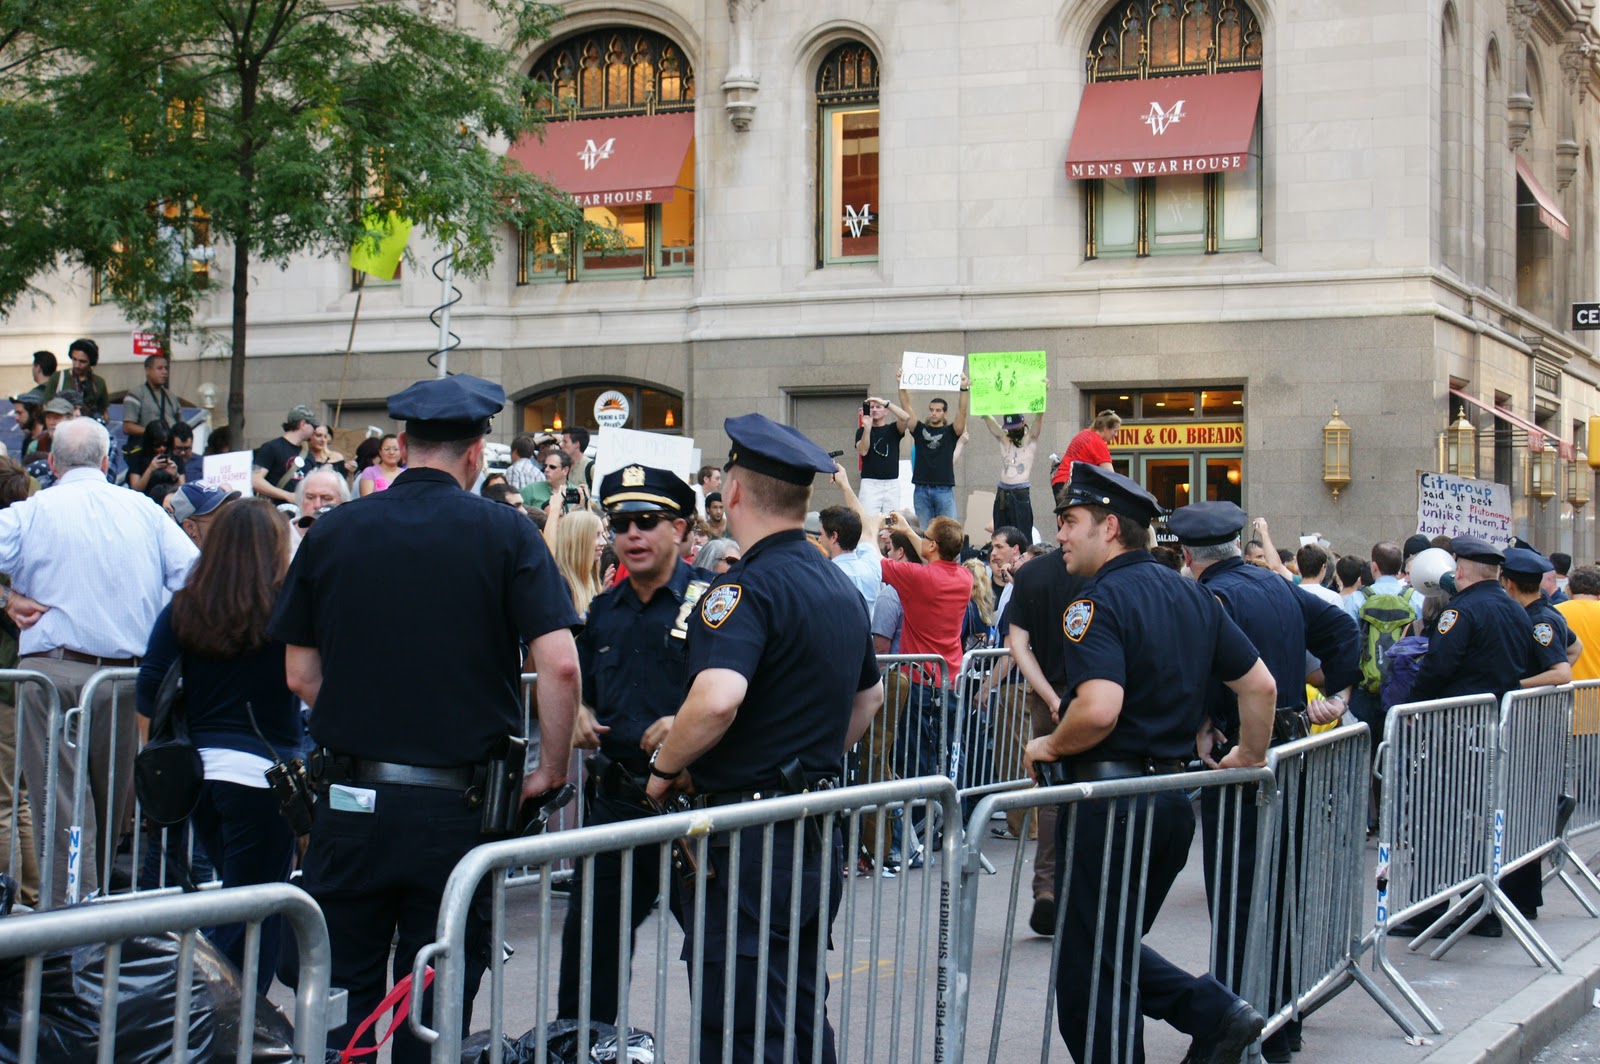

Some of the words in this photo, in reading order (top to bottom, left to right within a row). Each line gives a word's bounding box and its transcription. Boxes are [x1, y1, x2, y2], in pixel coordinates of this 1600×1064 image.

[1071, 163, 1122, 177] MEN'S
[1132, 156, 1241, 175] WEARHOUSE
[569, 190, 653, 206] EARHOUSE
[915, 356, 947, 370] END
[902, 372, 959, 386] LOBBYING
[1107, 429, 1139, 445] NINI
[1143, 428, 1155, 445] &
[1160, 428, 1182, 444] CO.
[1186, 427, 1242, 444] BREADS
[1421, 473, 1492, 499] Citigroup
[1423, 490, 1445, 500] said
[1457, 493, 1465, 502] it
[1423, 500, 1440, 508] this
[1445, 501, 1452, 509] is
[1423, 509, 1461, 521] unlike
[1467, 514, 1499, 530] them,
[1500, 520, 1507, 531] I
[1452, 526, 1470, 537] find
[1473, 529, 1488, 539] that
[1493, 812, 1504, 875] NYPD
[1377, 847, 1389, 922] NPD
[939, 880, 950, 959] FRIEDRICHS
